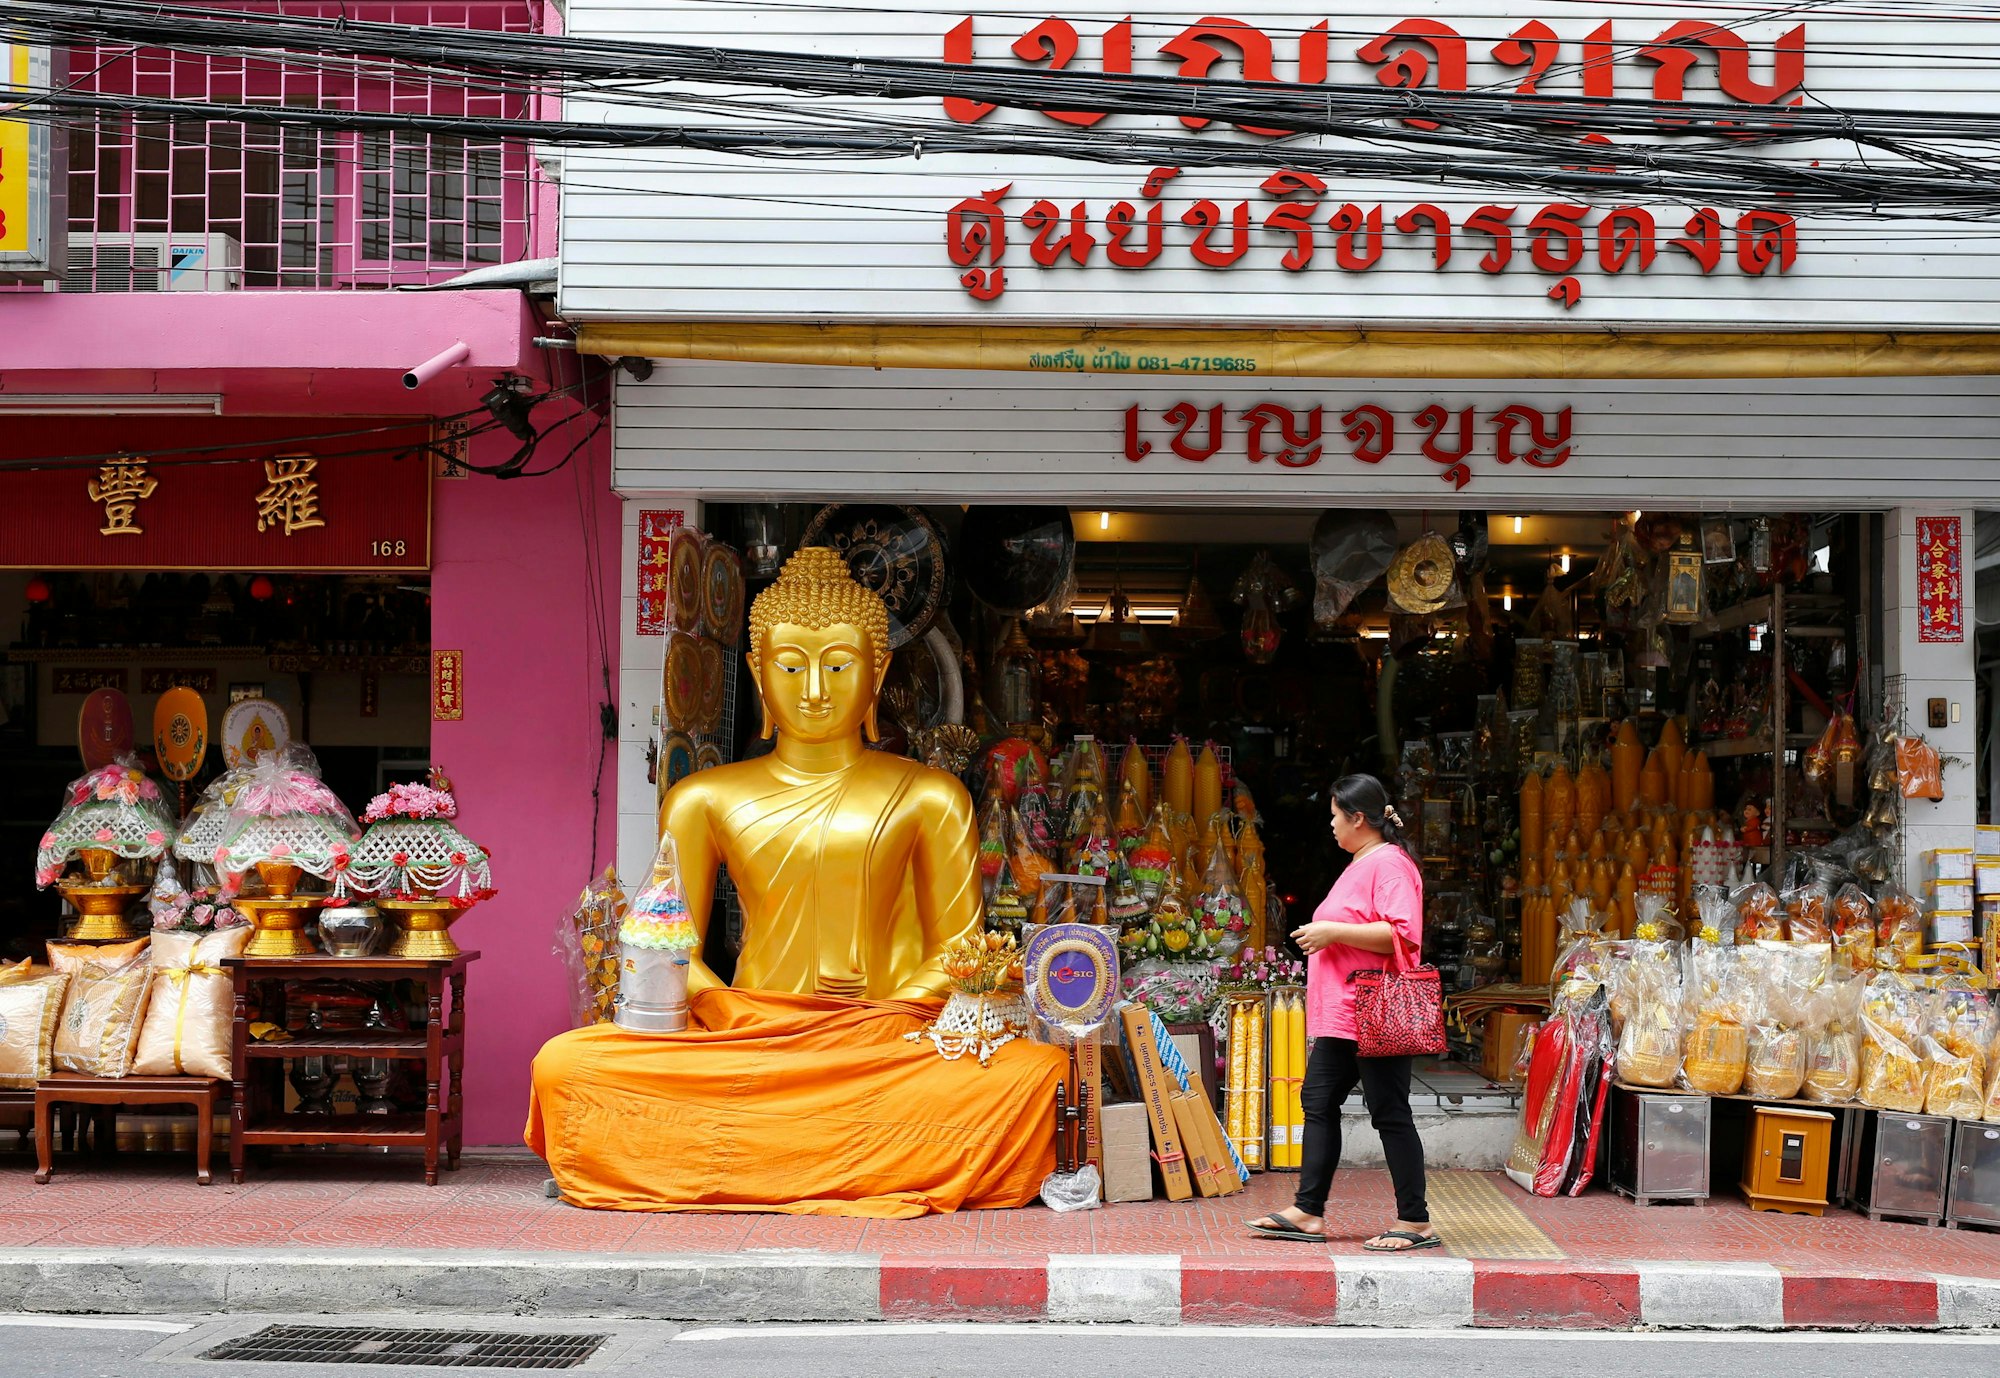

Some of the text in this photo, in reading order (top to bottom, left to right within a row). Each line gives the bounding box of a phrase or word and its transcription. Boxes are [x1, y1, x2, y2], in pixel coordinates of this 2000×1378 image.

[172, 247, 205, 255] DAIKIN
[946, 166, 1798, 310] ศูนย์บริขารธุดงค
[1138, 356, 1256, 372] 081-4719685
[1125, 401, 1571, 491] เบญจบุญ
[370, 540, 406, 557] 168
[1929, 539, 1950, 623] 合家平安
